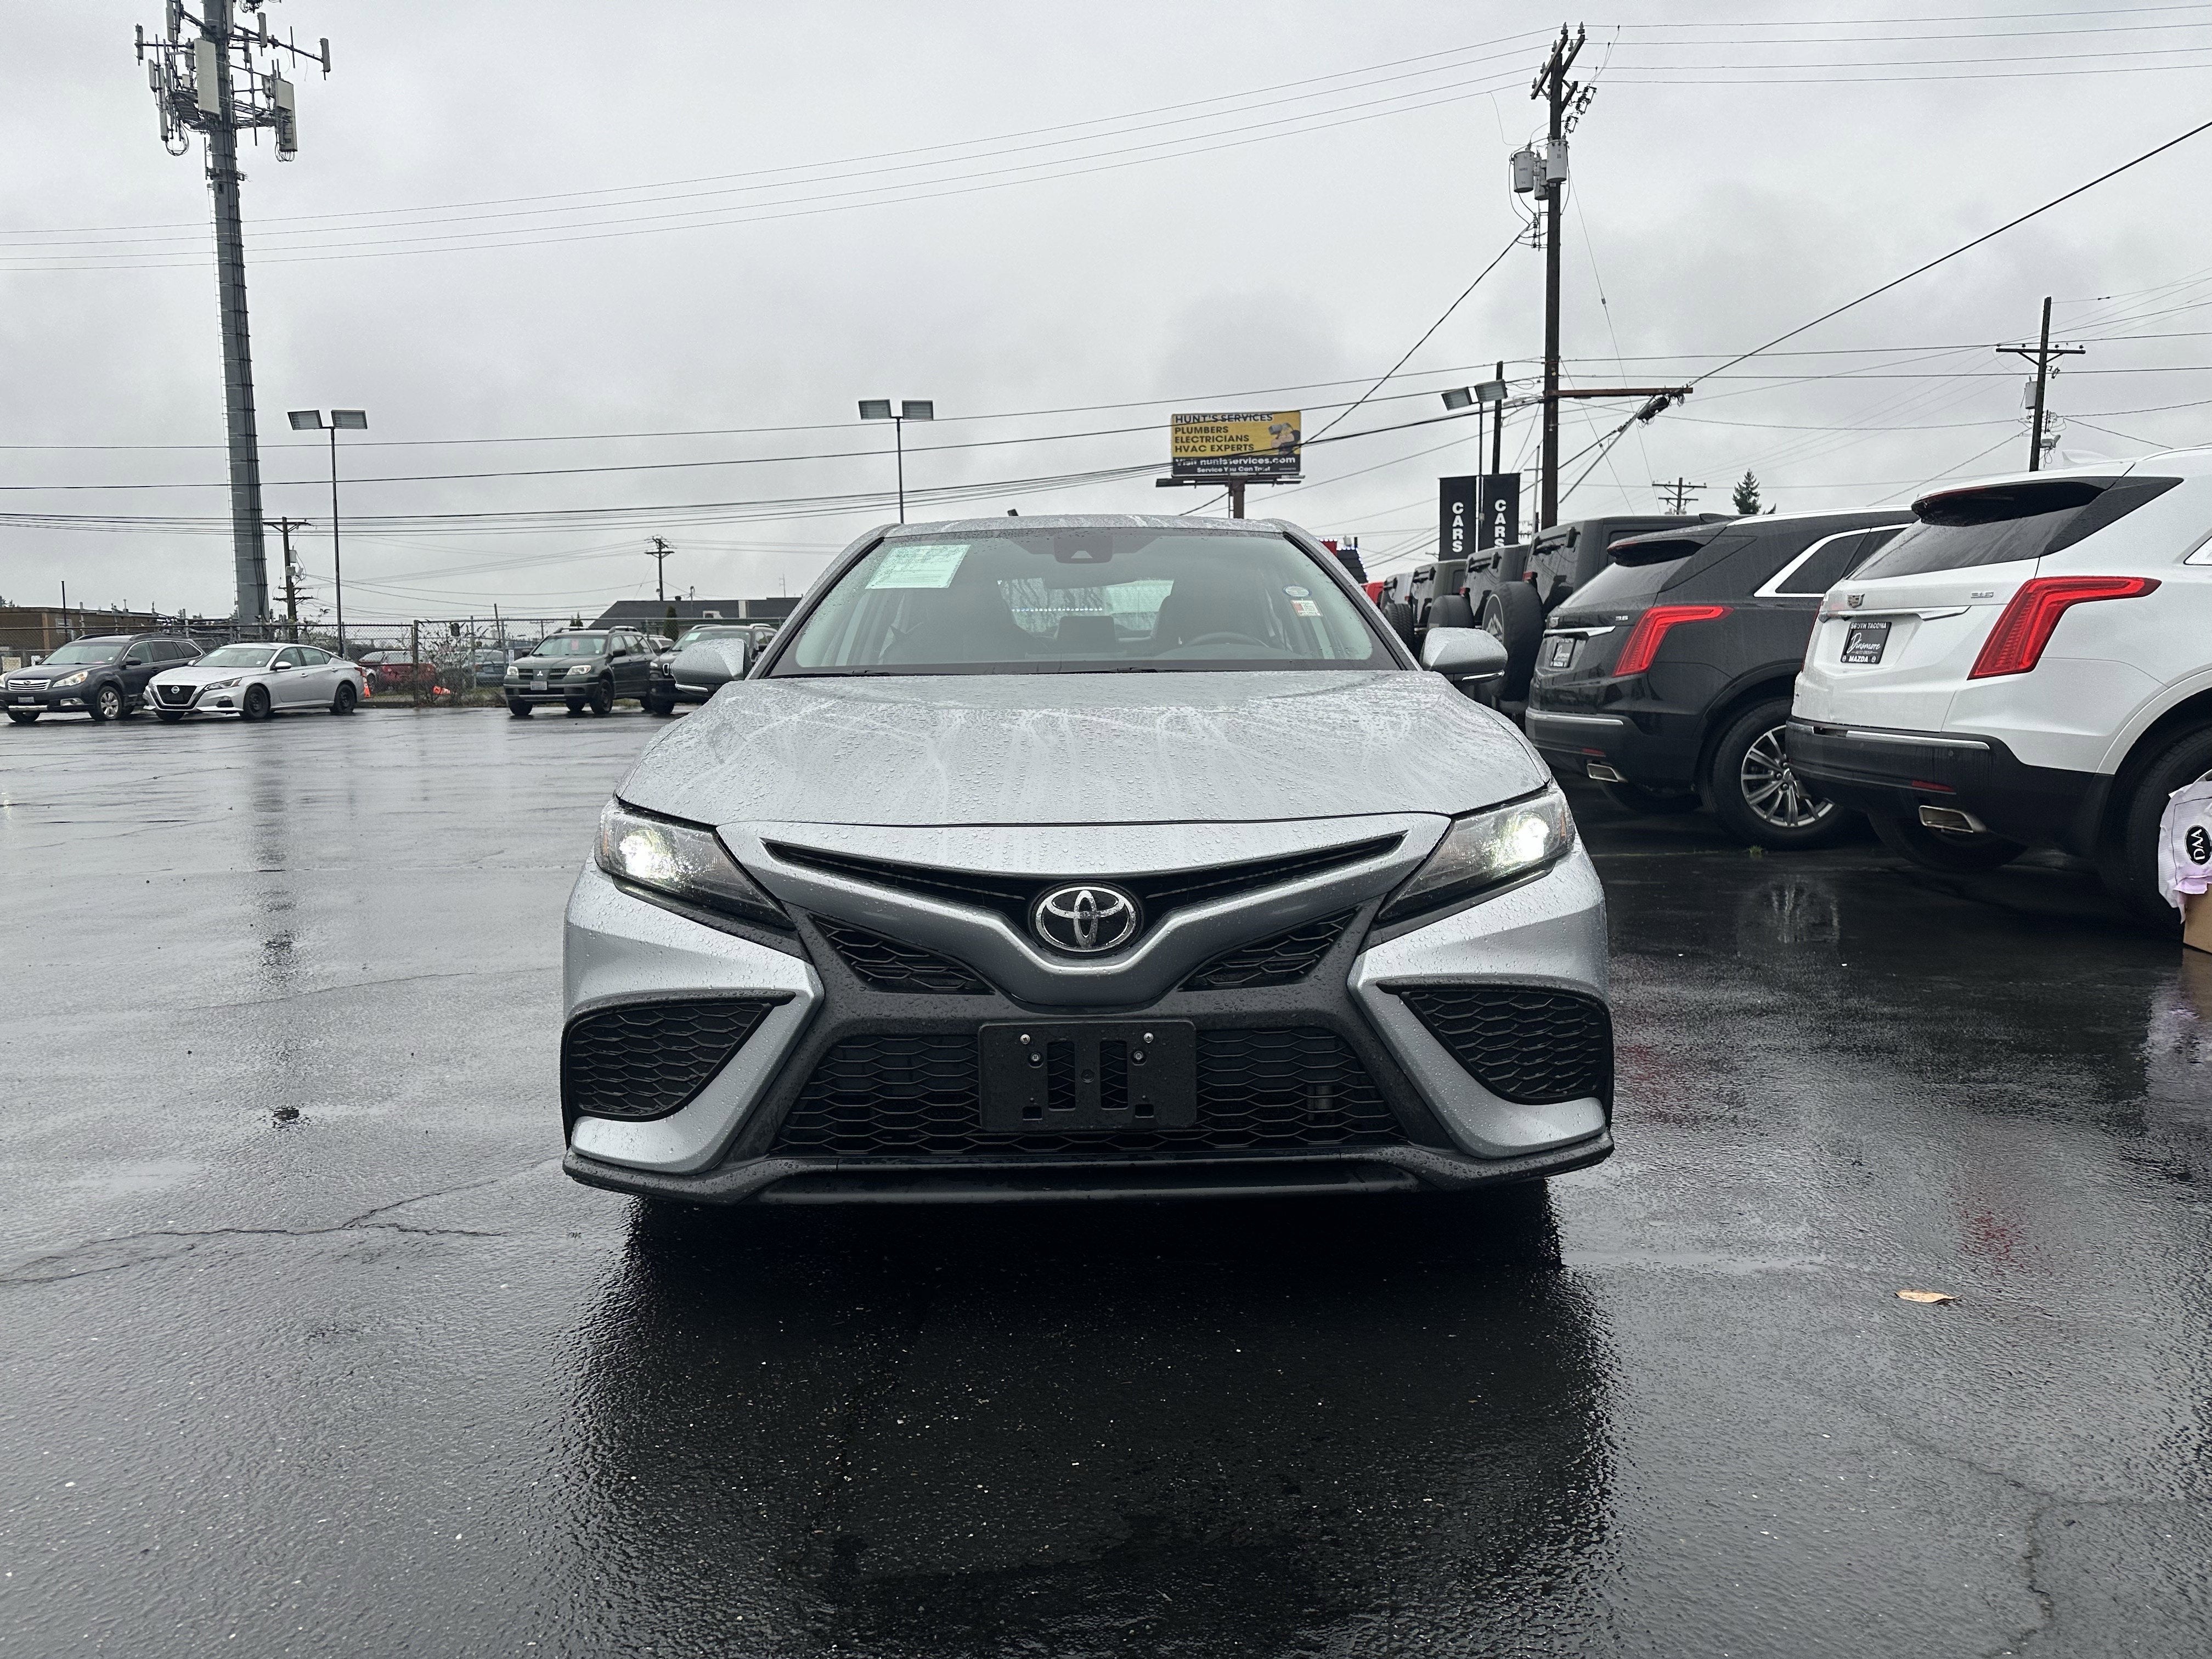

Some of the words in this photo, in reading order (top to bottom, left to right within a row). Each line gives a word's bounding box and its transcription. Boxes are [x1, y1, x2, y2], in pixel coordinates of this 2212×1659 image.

[1176, 415, 1218, 424] HUNT'S
[1221, 413, 1273, 422] SERVICES
[1175, 426, 1229, 435] PLUMBERS
[1175, 435, 1250, 443] ELECTRICIANS
[1210, 443, 1255, 452] EXPERTS
[1452, 501, 1464, 553] CARS
[1494, 499, 1506, 549] CARS
[2191, 829, 2205, 860] DAA
